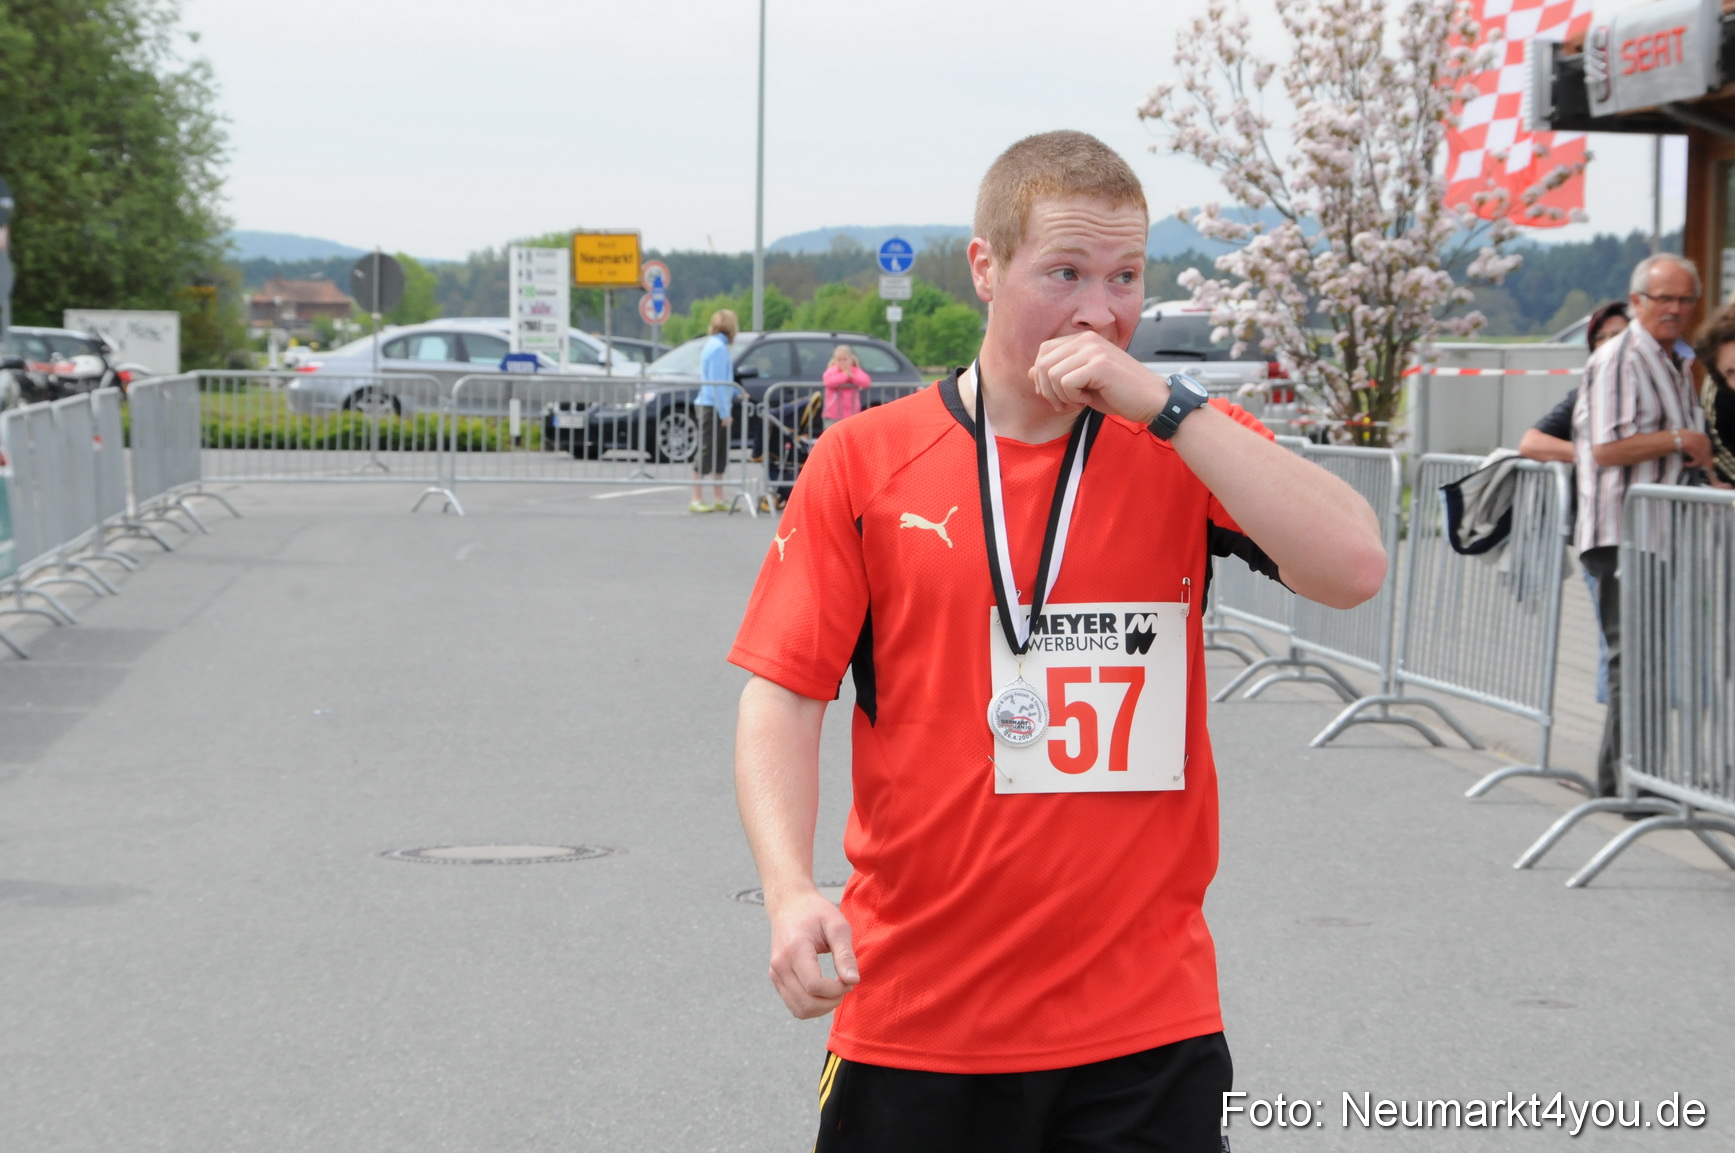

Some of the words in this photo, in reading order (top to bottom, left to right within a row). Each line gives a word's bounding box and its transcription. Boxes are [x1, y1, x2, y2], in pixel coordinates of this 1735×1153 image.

[1620, 25, 1688, 76] SEAT
[580, 252, 634, 264] Neumarkt
[1026, 613, 1118, 635] MEYER
[1028, 636, 1119, 652] WERBUNG
[1046, 666, 1145, 774] 57
